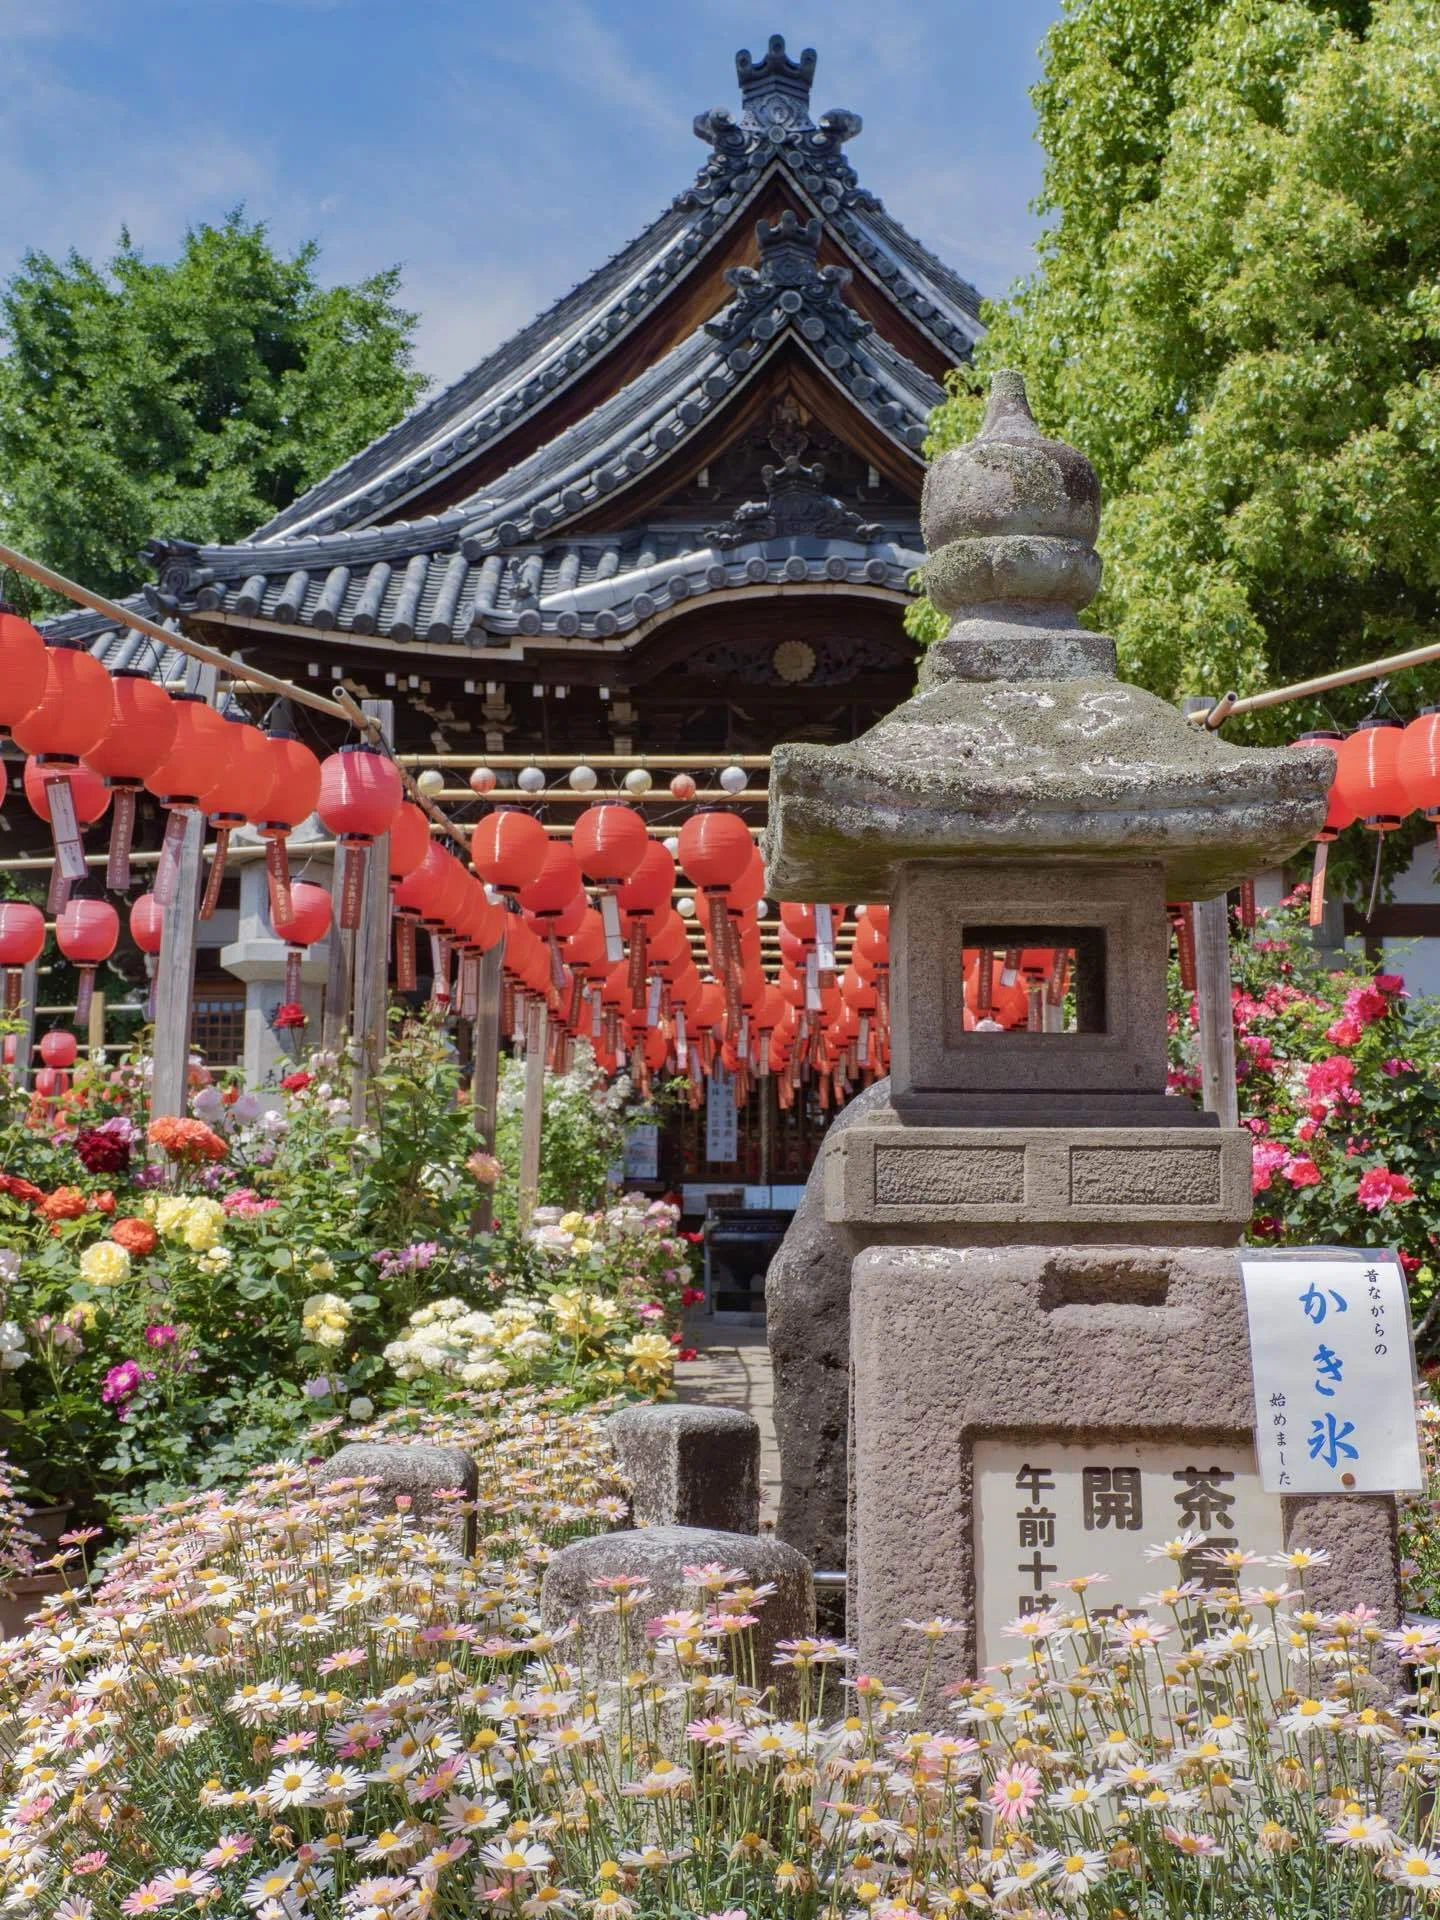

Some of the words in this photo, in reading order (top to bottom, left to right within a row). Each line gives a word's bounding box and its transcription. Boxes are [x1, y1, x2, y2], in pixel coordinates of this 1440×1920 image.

[1364, 1269, 1388, 1356] 昔ながらの
[1299, 1282, 1360, 1469] かき氷
[1269, 1392, 1292, 1487] 始めました
